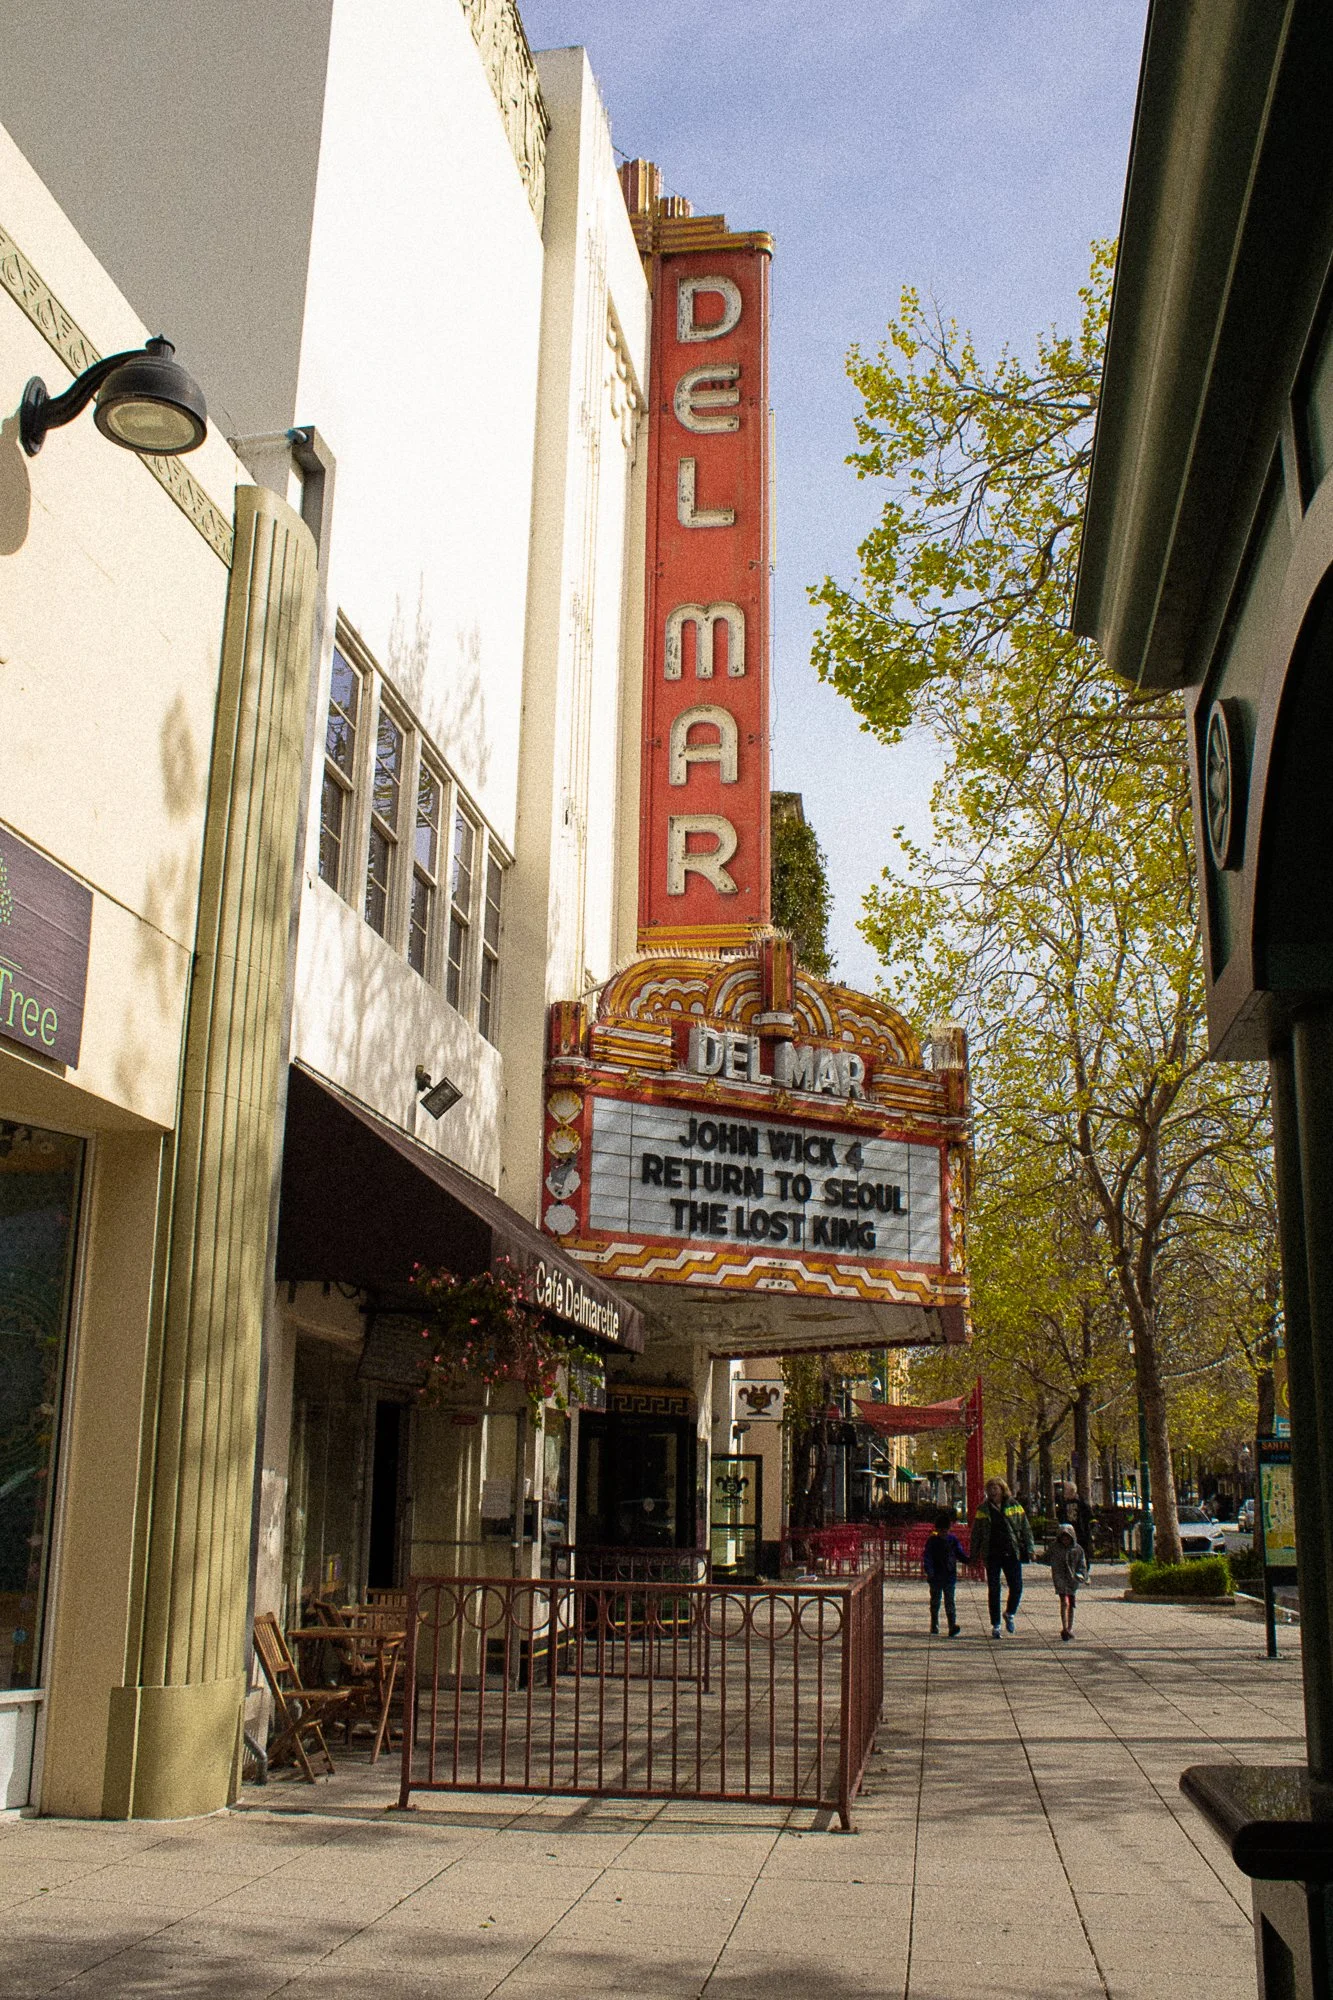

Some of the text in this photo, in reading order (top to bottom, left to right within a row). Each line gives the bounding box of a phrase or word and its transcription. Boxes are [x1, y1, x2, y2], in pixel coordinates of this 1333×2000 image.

[663, 274, 746, 898] DEL MAR
[689, 1026, 867, 1100] DEL MAR
[679, 1117, 865, 1172] JOHN WICK 4
[641, 1152, 908, 1216] RETURN TO SEOUL
[670, 1197, 877, 1251] THE LOST KING
[536, 1261, 619, 1340] Café Delmarette
